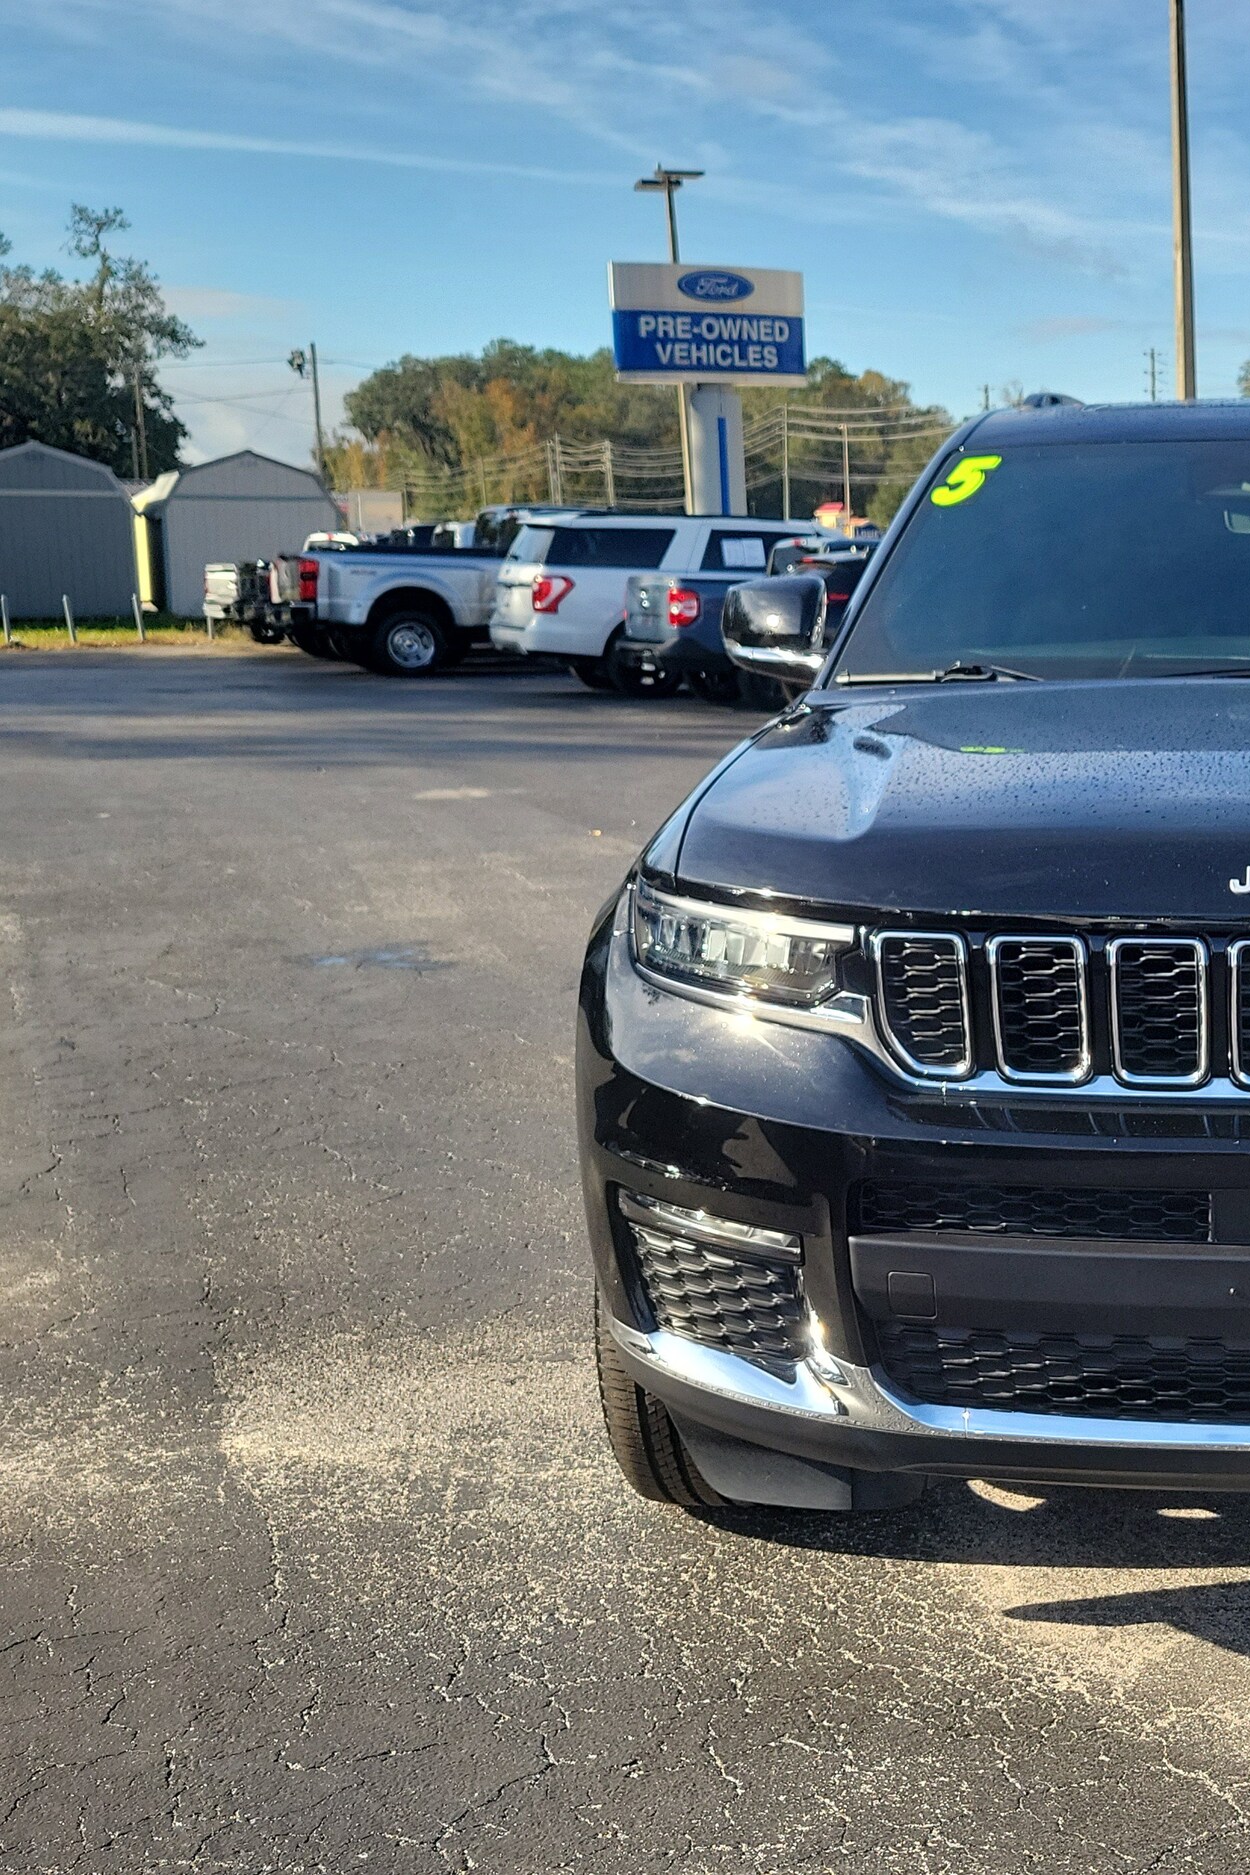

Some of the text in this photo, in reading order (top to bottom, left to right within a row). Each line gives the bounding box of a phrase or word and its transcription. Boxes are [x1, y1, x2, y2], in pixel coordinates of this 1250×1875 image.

[696, 277, 739, 297] Ford
[638, 314, 790, 343] PRE-OWNED
[656, 342, 778, 368] VEHICLES
[930, 455, 1002, 506] 5
